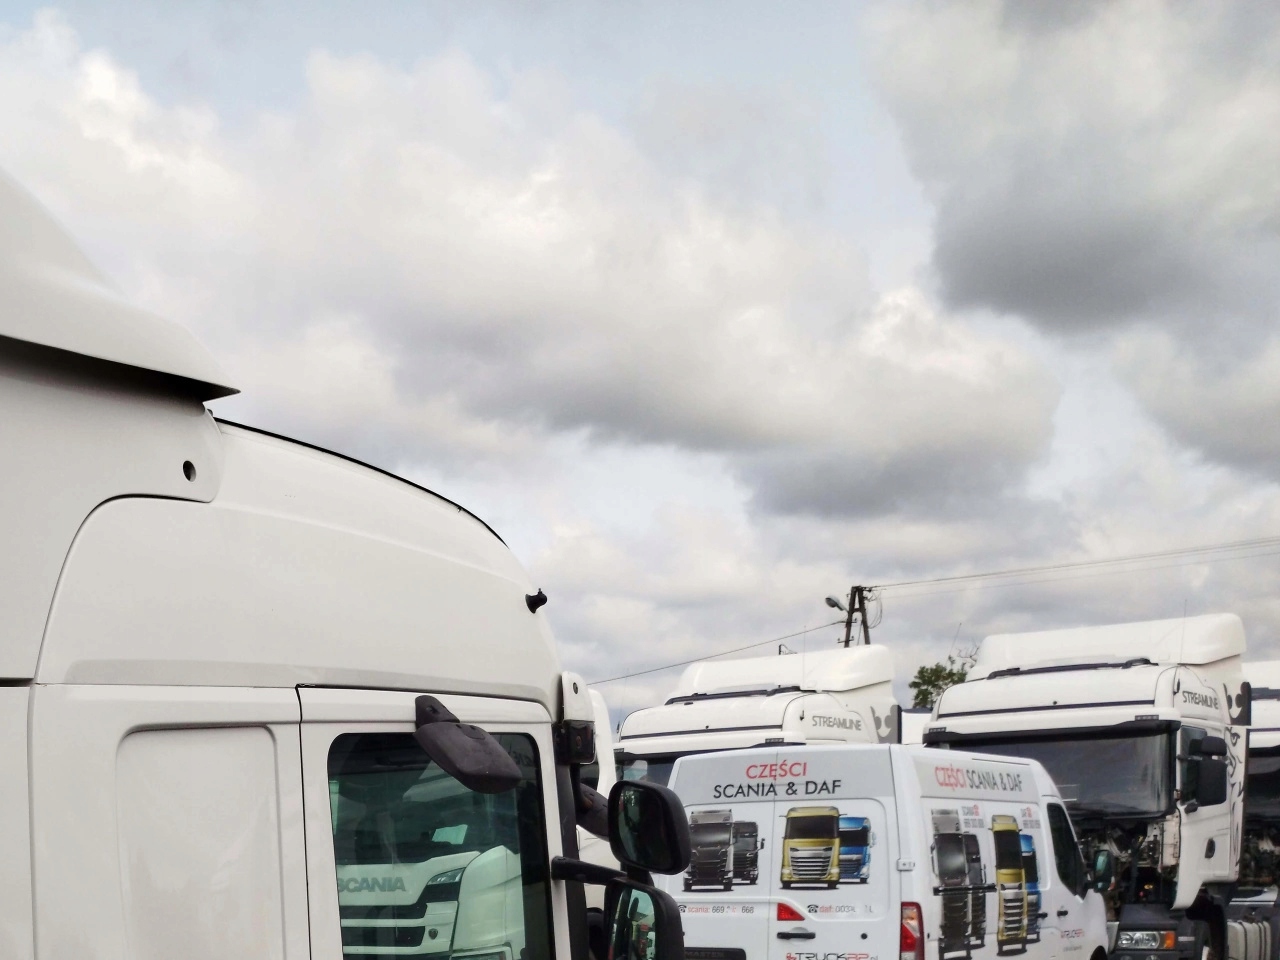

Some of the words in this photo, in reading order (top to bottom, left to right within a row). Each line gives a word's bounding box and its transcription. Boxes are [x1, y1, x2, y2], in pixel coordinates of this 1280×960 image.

[1182, 690, 1219, 710] STREAMLINE
[812, 715, 862, 731] STREAMLINE
[745, 759, 808, 781] CZĘŚCI
[713, 783, 778, 799] SCANIA
[785, 781, 798, 796] &
[804, 779, 842, 795] DAF
[966, 769, 999, 790] SCANIA
[999, 774, 1007, 791] &
[1006, 773, 1023, 792] DAF
[337, 876, 407, 893] SCANIA
